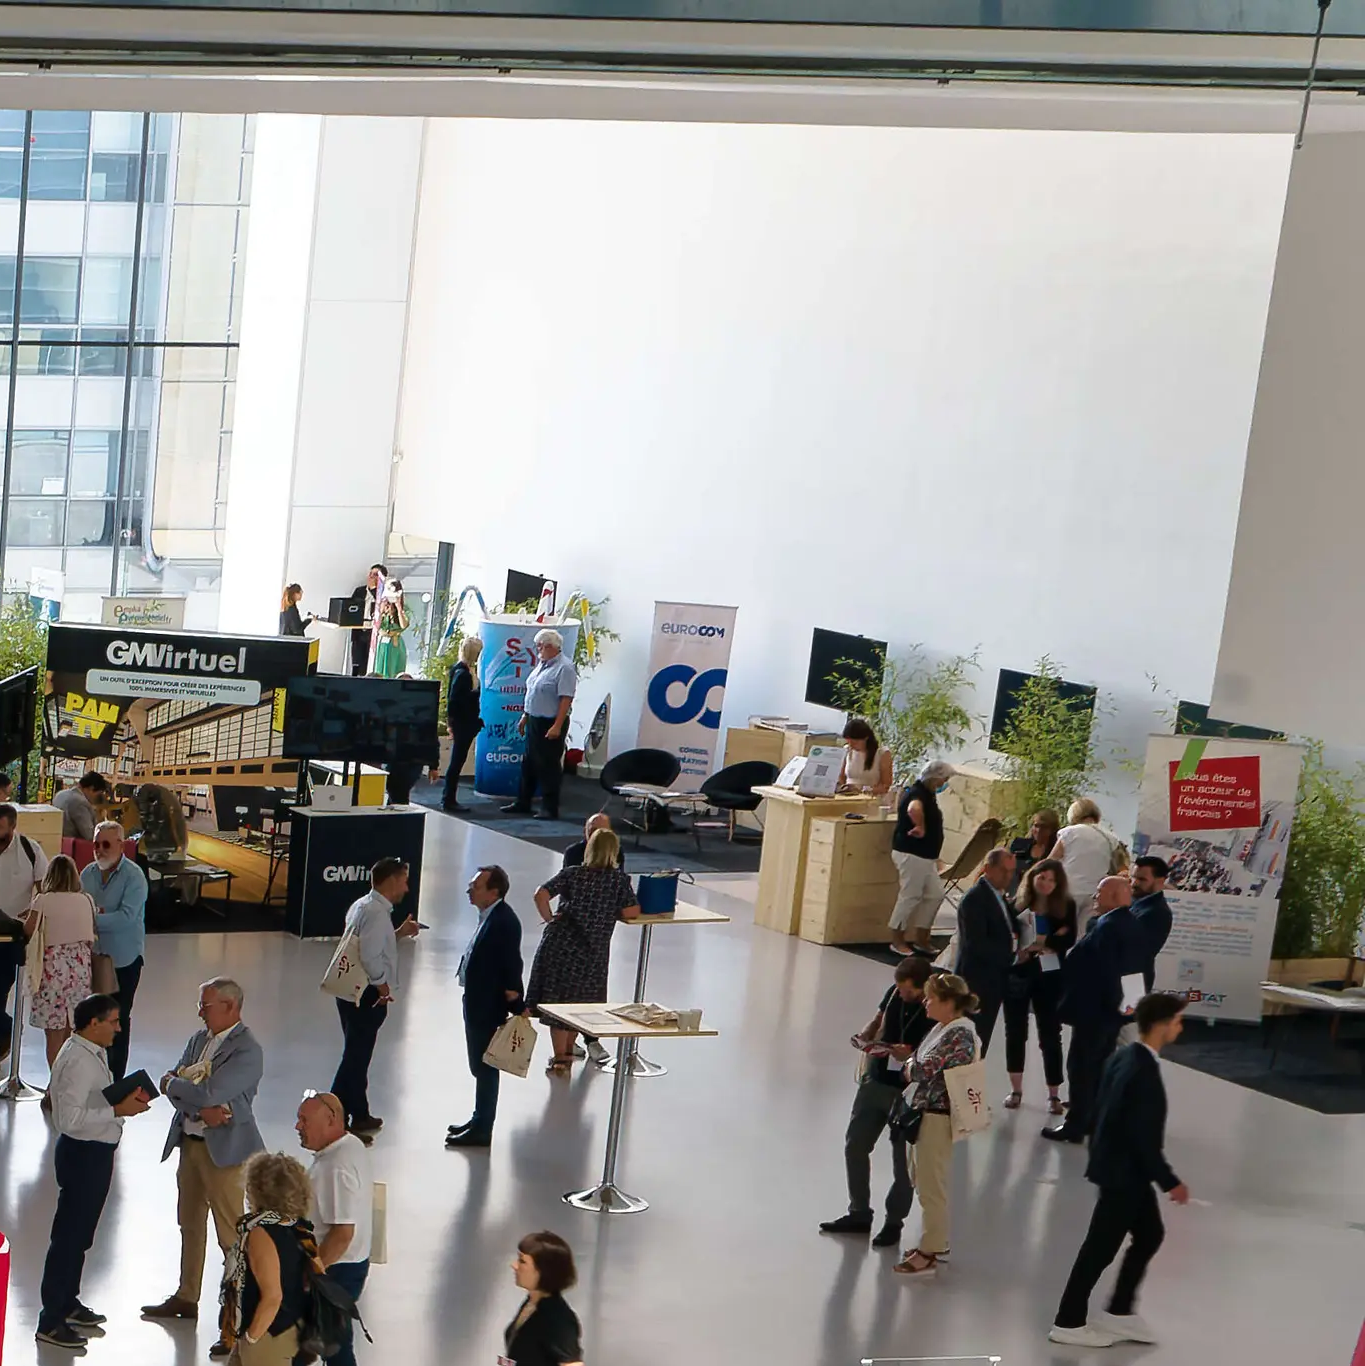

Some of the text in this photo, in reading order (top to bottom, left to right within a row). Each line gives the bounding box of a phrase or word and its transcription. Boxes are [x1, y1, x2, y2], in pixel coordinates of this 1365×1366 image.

[1180, 785, 1251, 797] un acteur de
